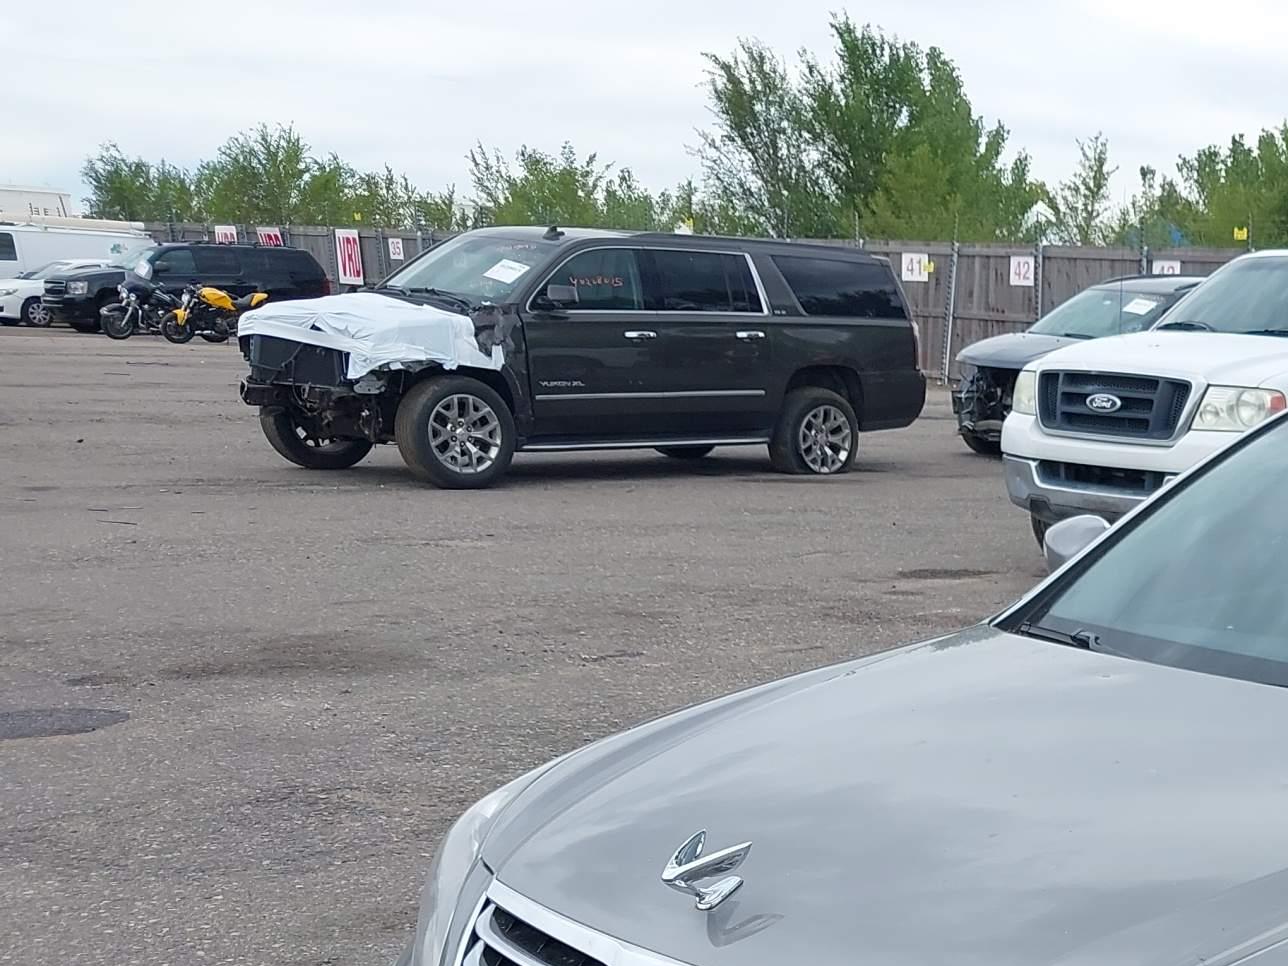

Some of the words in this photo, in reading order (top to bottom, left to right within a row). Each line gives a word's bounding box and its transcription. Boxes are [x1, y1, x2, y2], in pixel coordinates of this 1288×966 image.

[337, 236, 361, 278] VRD
[390, 241, 401, 256] 35
[906, 257, 922, 276] 41
[1014, 260, 1030, 280] 42
[1092, 396, 1113, 408] Ford
